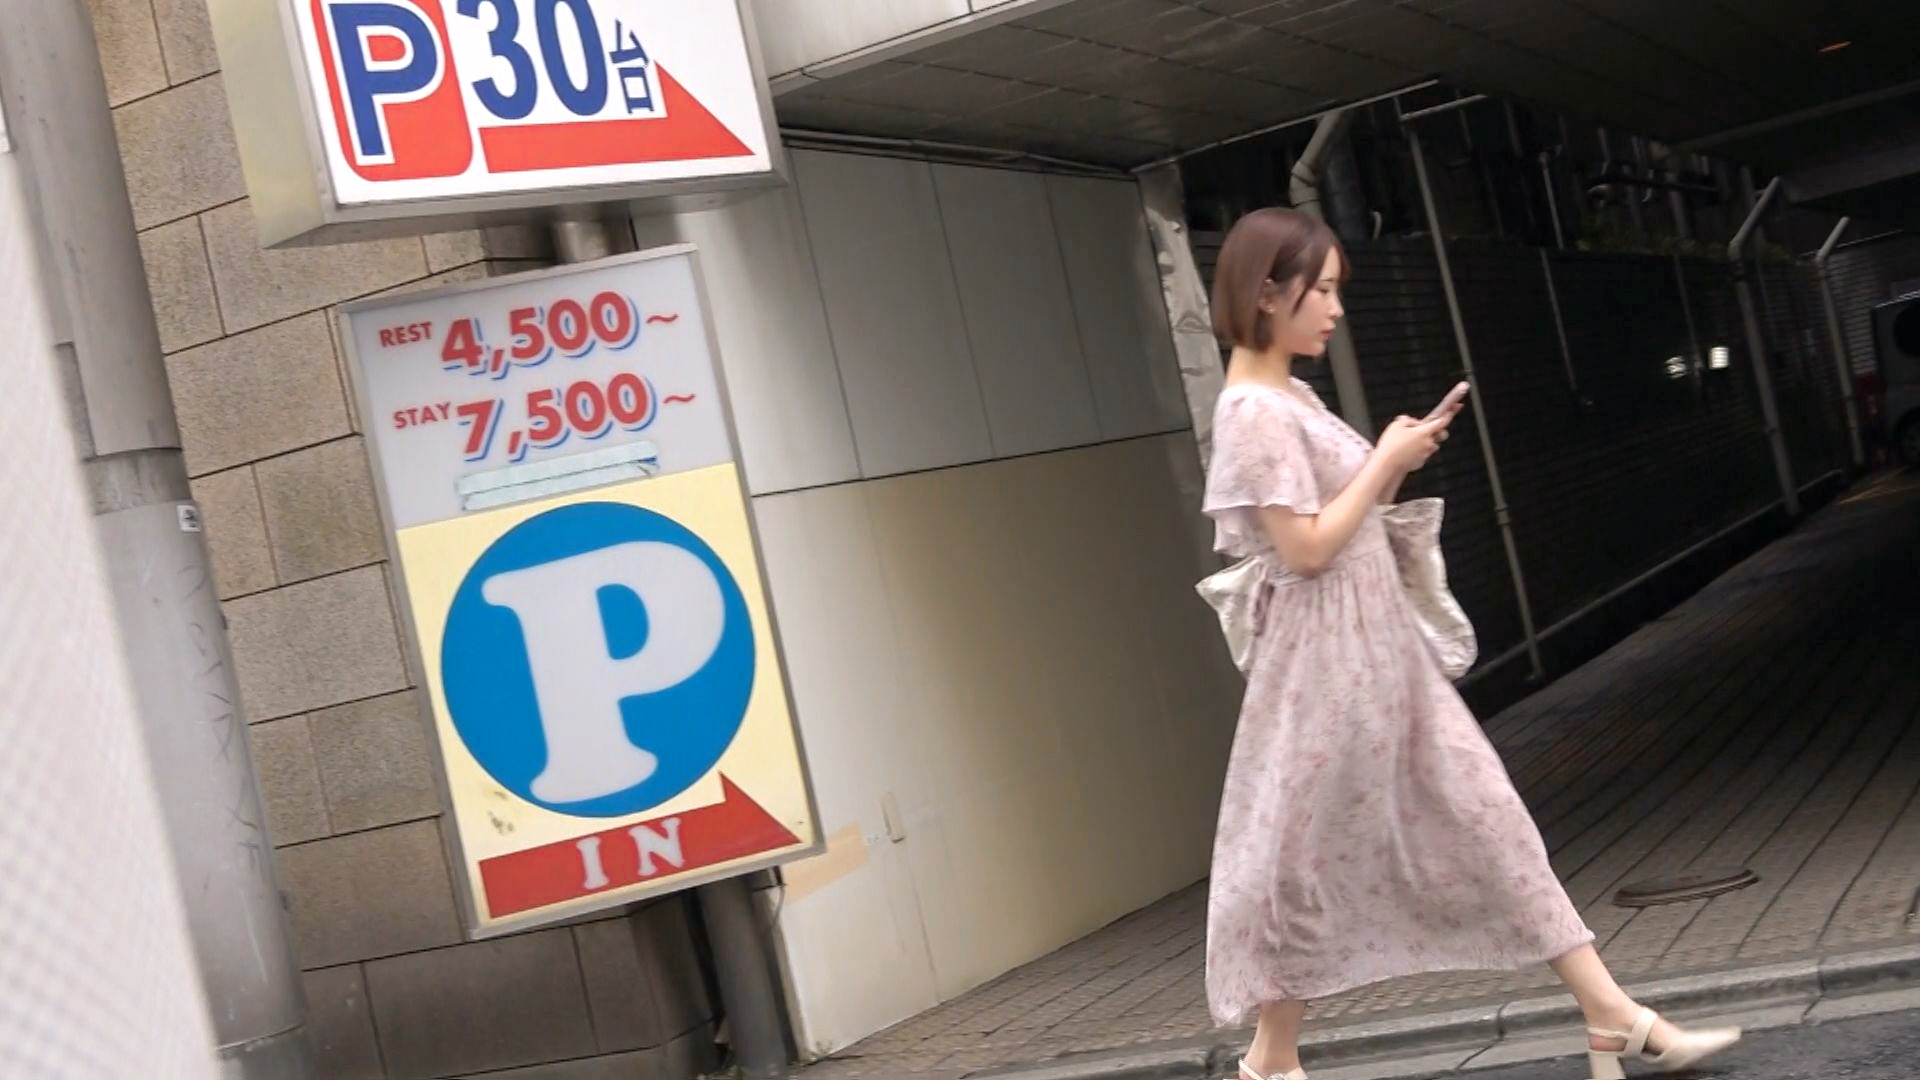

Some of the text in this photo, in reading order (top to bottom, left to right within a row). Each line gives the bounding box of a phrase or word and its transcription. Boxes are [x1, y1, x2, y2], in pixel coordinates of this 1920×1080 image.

[329, 2, 438, 156] P
[379, 321, 433, 348] REST
[393, 402, 451, 430] STAY
[481, 540, 726, 804] P
[576, 817, 685, 890] IN
